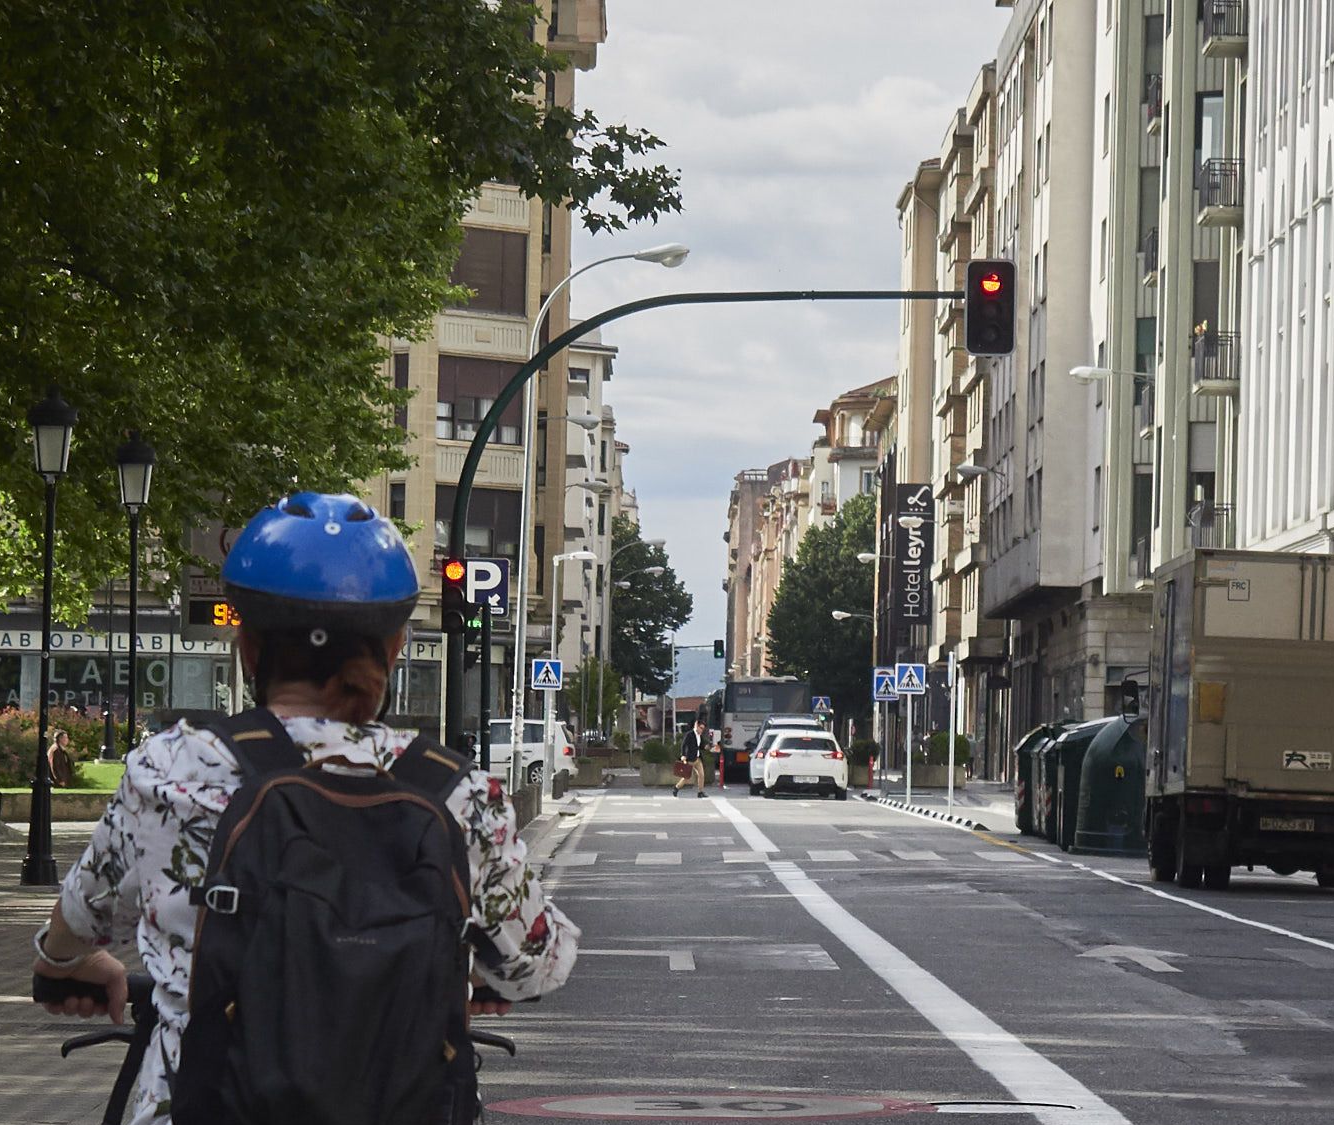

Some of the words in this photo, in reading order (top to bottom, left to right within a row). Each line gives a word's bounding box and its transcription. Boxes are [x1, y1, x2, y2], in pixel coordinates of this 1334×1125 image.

[902, 518, 925, 566] leyr
[466, 561, 503, 604] P
[1230, 581, 1247, 591] FRC
[634, 1100, 808, 1112] 30
